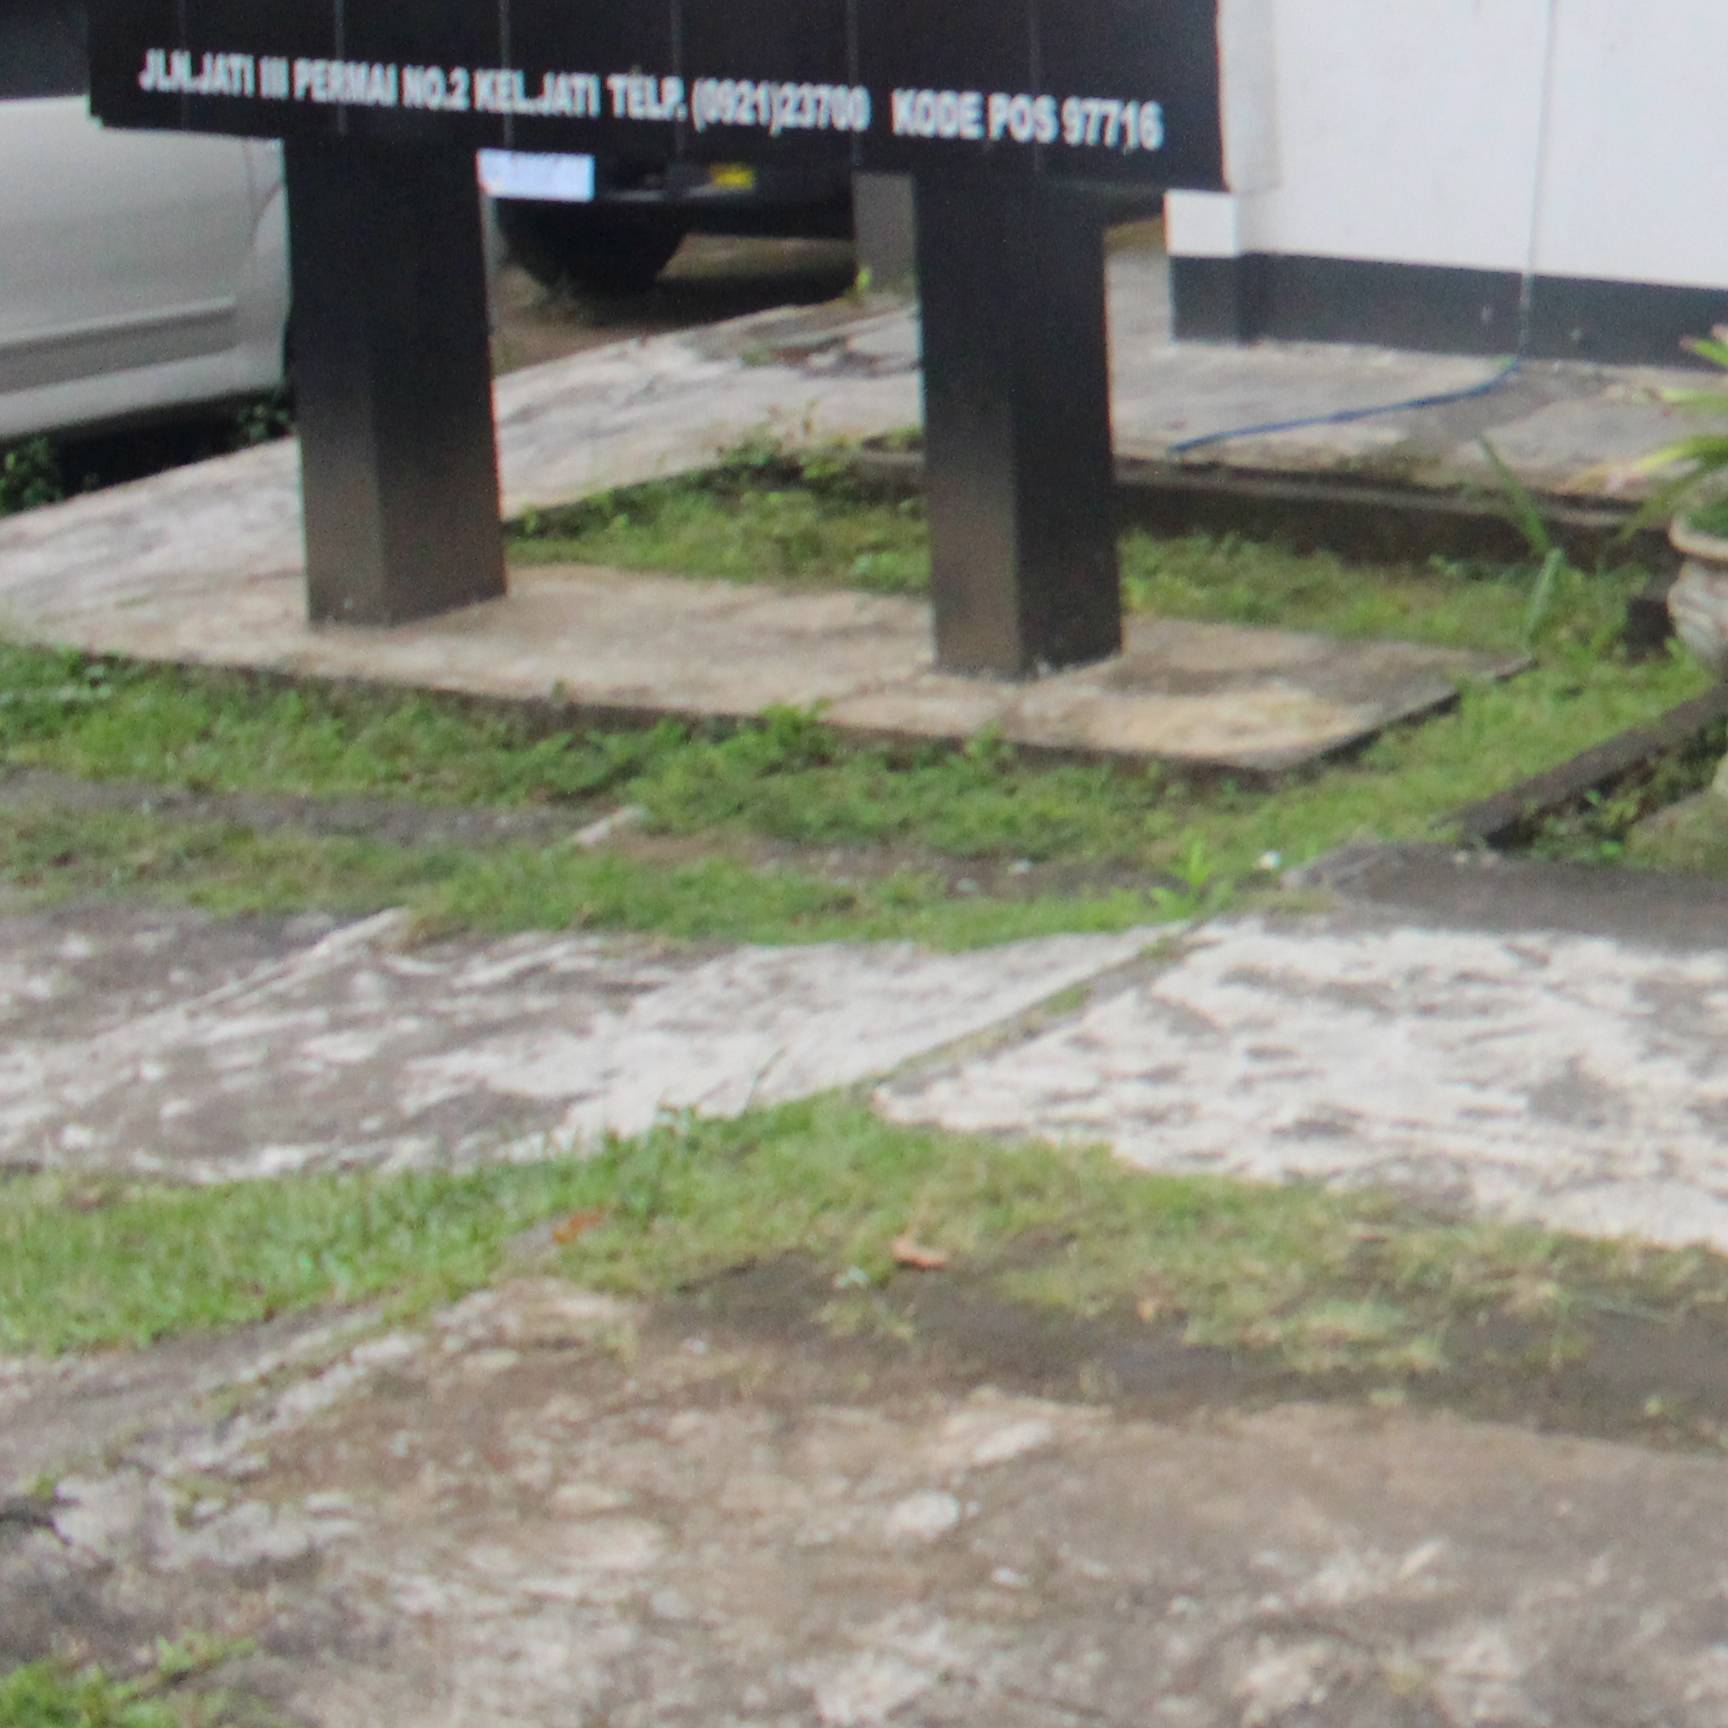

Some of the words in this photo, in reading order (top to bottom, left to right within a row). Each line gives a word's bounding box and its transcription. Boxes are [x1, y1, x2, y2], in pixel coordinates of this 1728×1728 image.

[260, 57, 289, 97] III
[402, 65, 469, 111] NO.2
[891, 89, 985, 139] KODE
[988, 93, 1059, 143] POS
[1062, 96, 1164, 150] 97716
